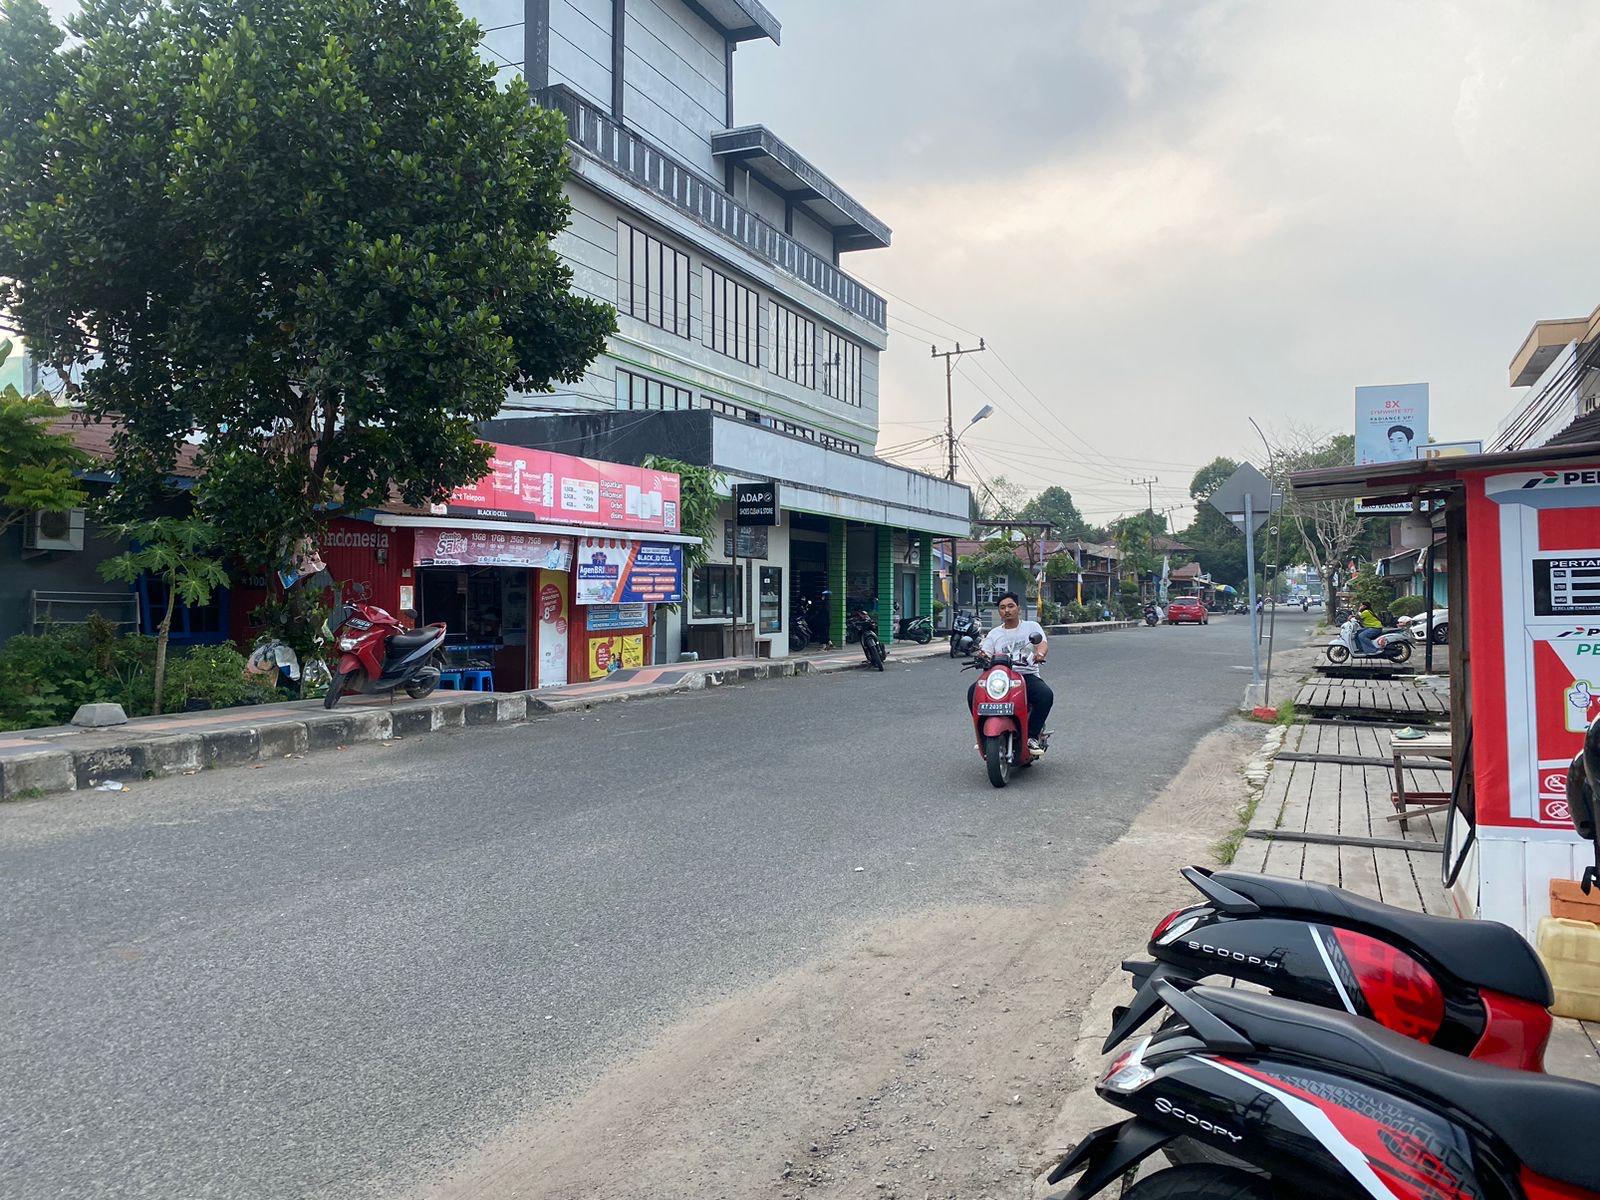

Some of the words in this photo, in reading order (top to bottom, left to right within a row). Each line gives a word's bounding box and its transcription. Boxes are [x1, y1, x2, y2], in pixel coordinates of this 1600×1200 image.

[600, 480, 622, 489] Dapatkan
[463, 493, 485, 502] Telepon
[600, 490, 623, 499] Telkomsel
[740, 493, 763, 502] ADAP
[471, 533, 487, 541] 13GB
[1188, 941, 1278, 968] SCOOPY
